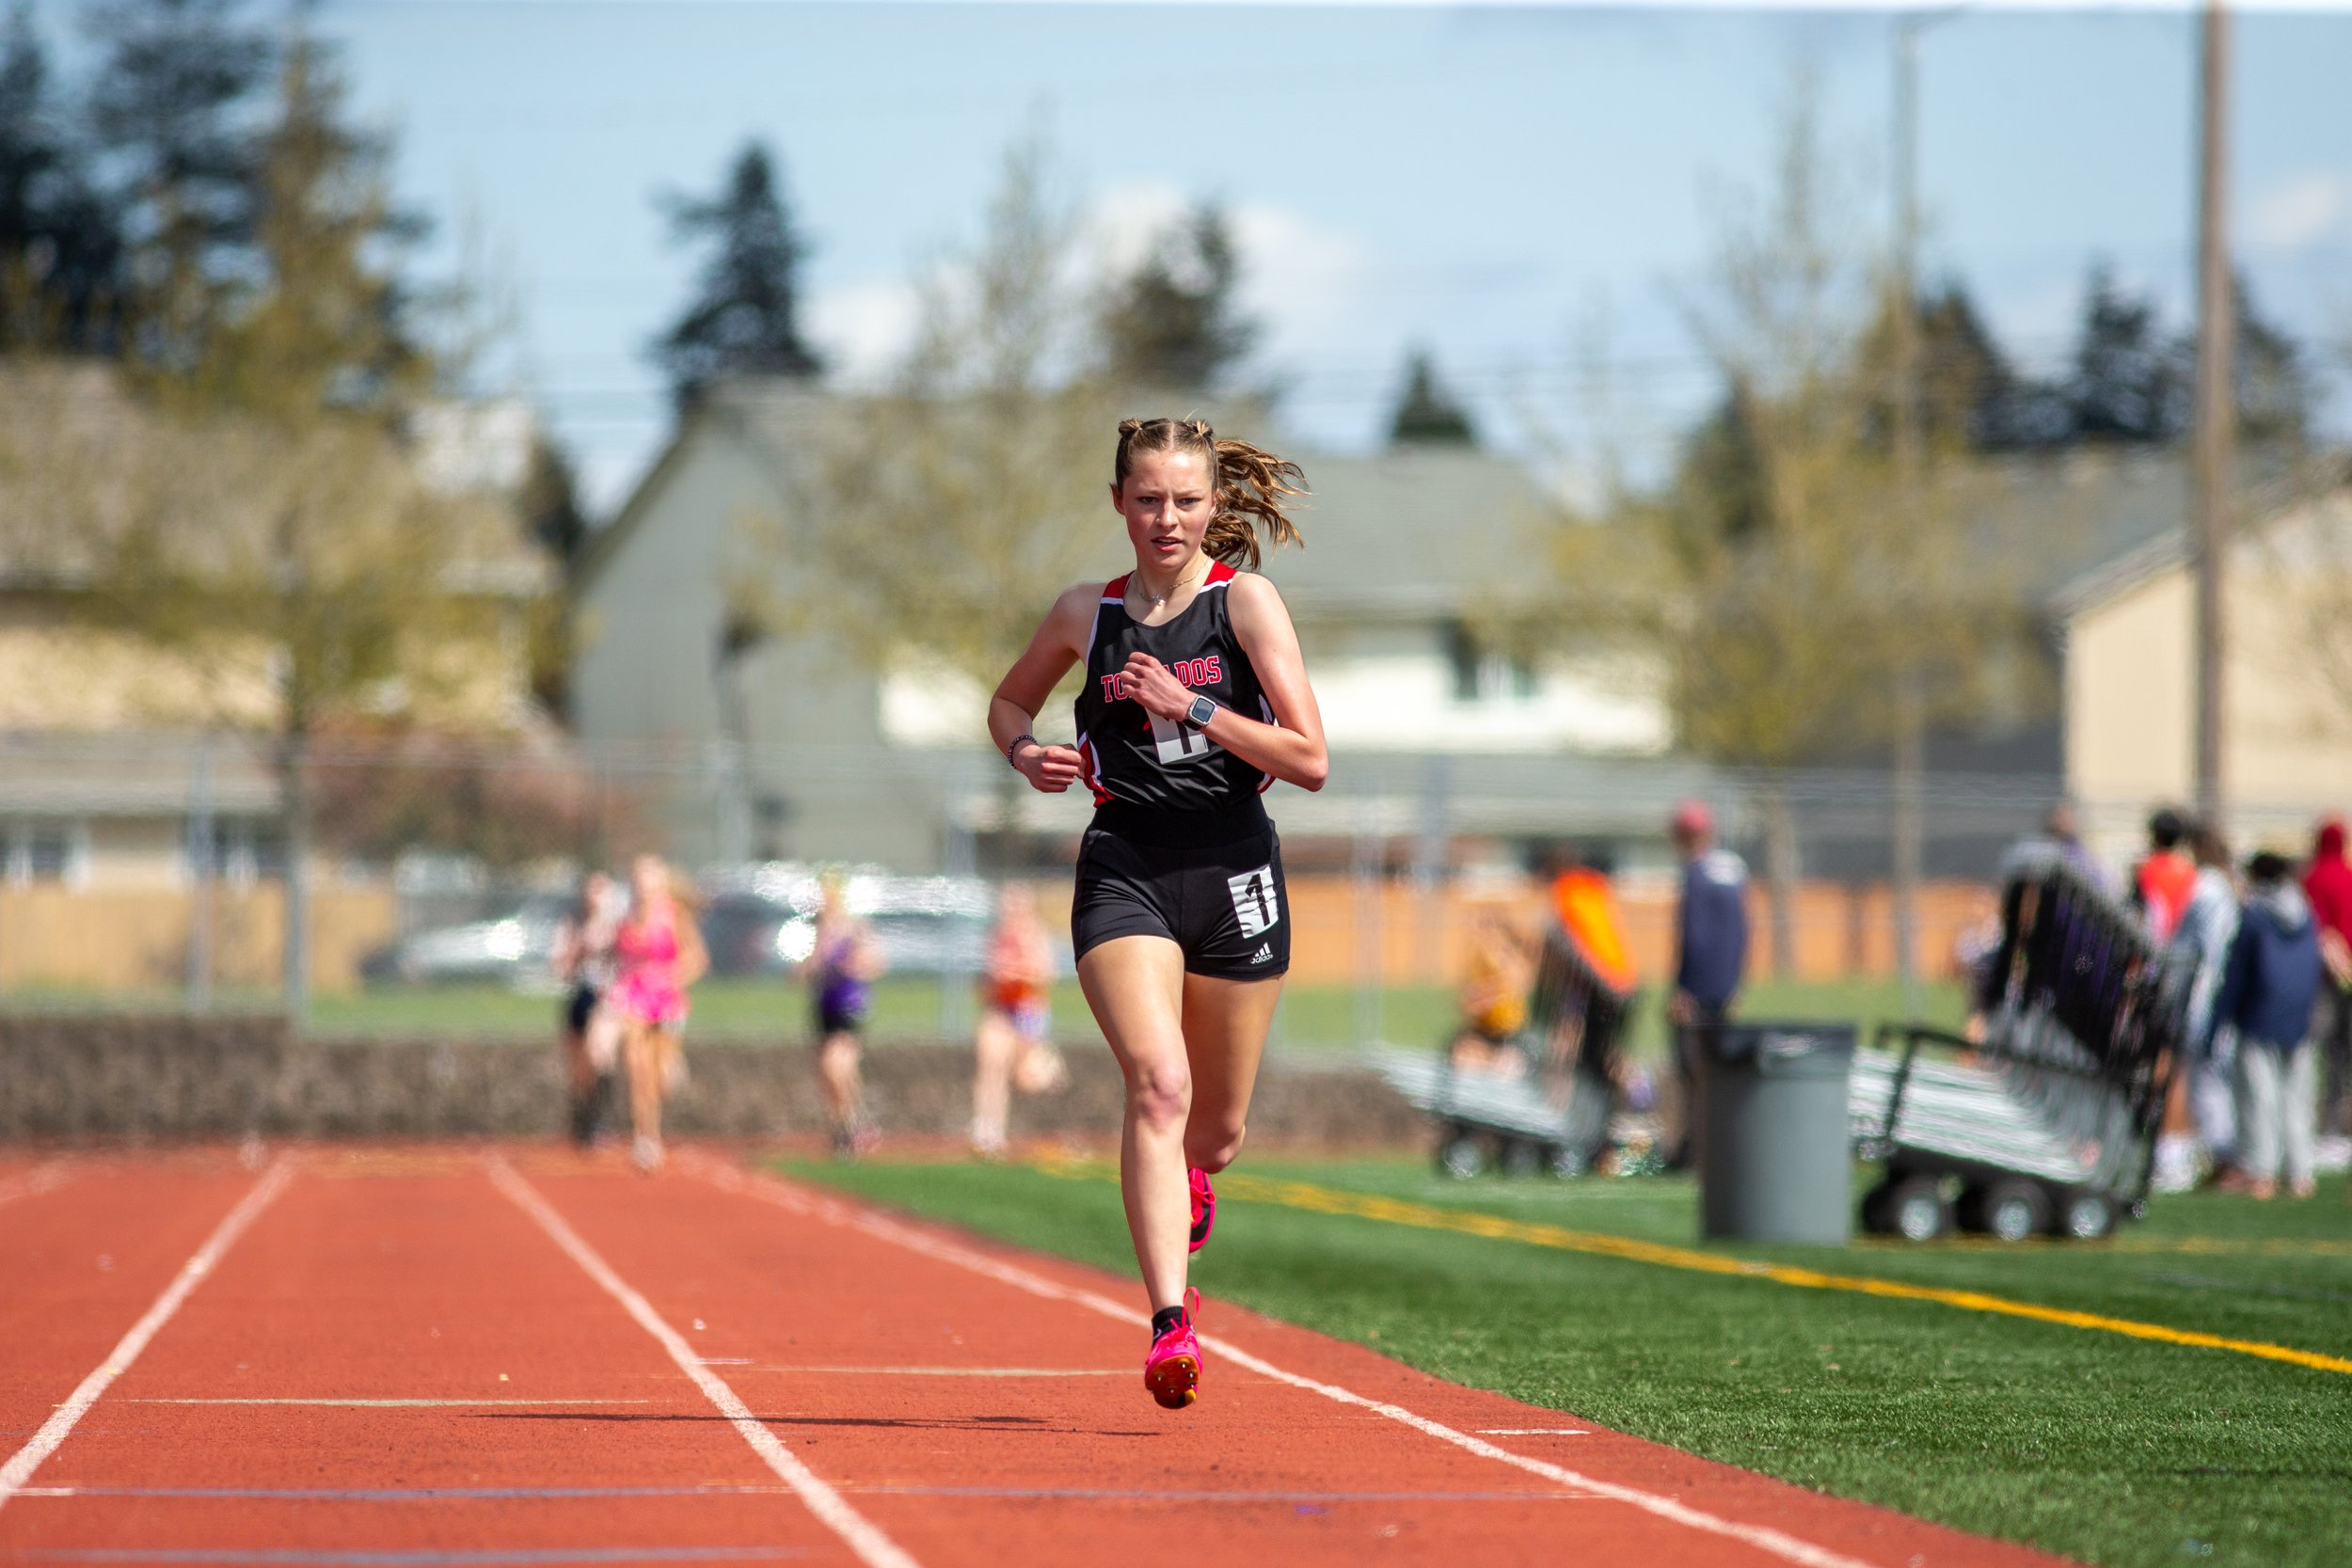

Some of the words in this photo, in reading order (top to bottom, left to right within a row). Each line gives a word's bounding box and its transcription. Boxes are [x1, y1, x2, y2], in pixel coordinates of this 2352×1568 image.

[1101, 655, 1223, 703] TODOS
[1245, 873, 1270, 927] 1
[1249, 954, 1274, 964] adidas
